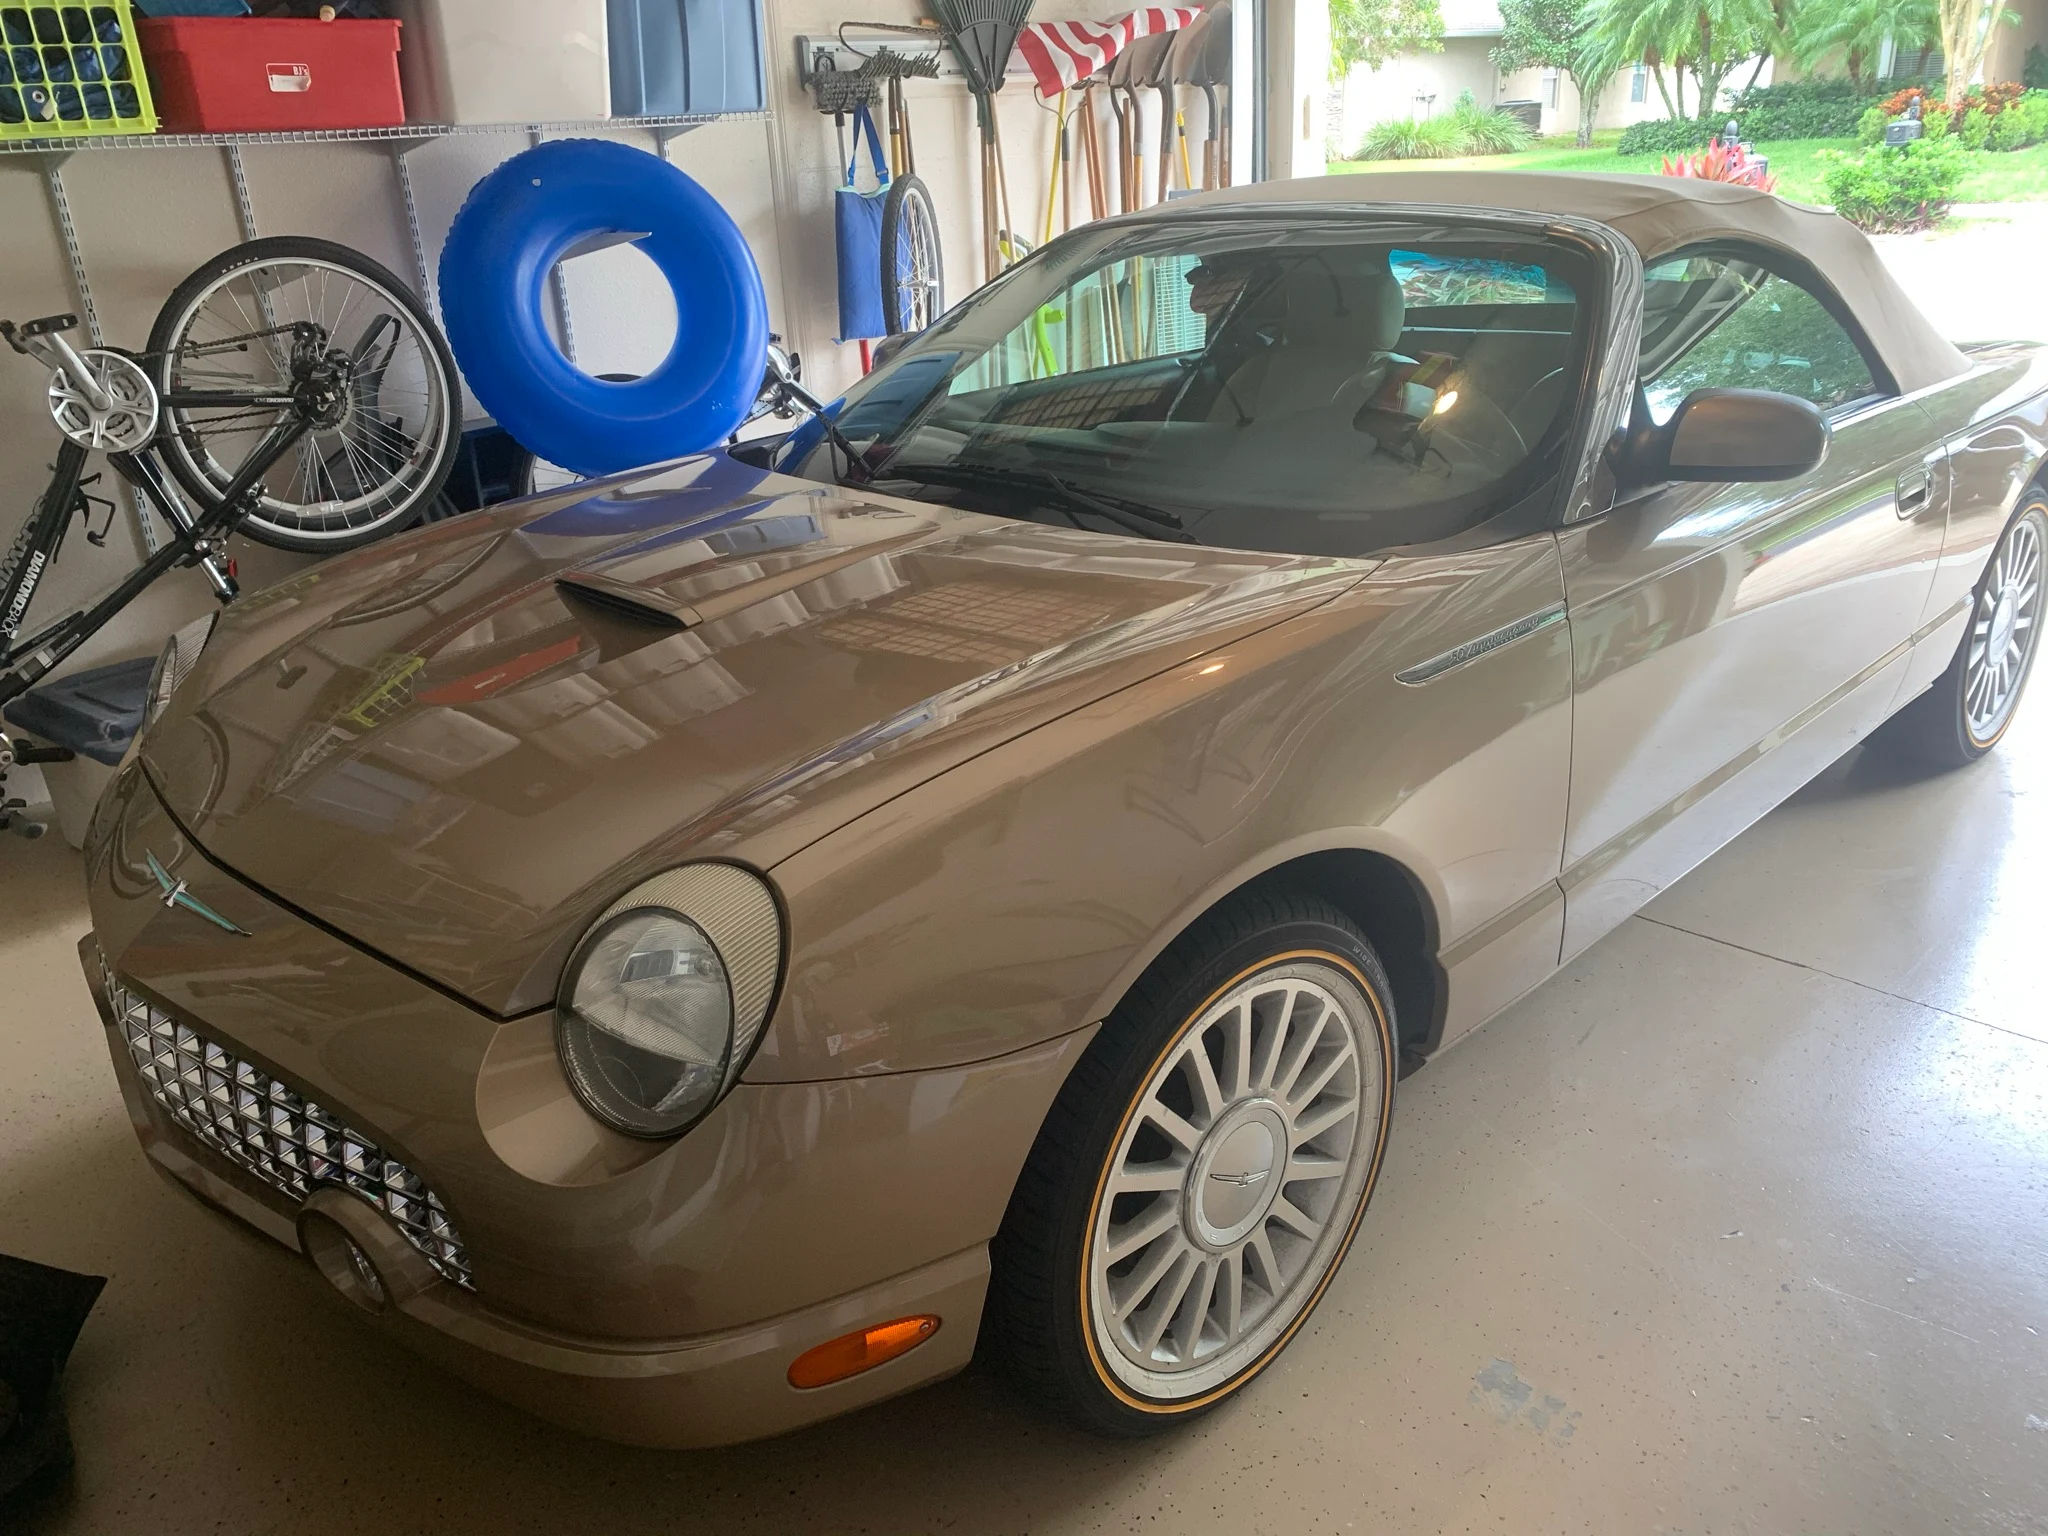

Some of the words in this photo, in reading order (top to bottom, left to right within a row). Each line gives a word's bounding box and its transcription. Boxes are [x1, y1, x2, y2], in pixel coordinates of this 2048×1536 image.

[292, 65, 309, 76] BJ's
[221, 256, 259, 274] KENDA
[0, 549, 46, 638] DIAMONDBACK
[1352, 945, 1372, 966] WIDE
